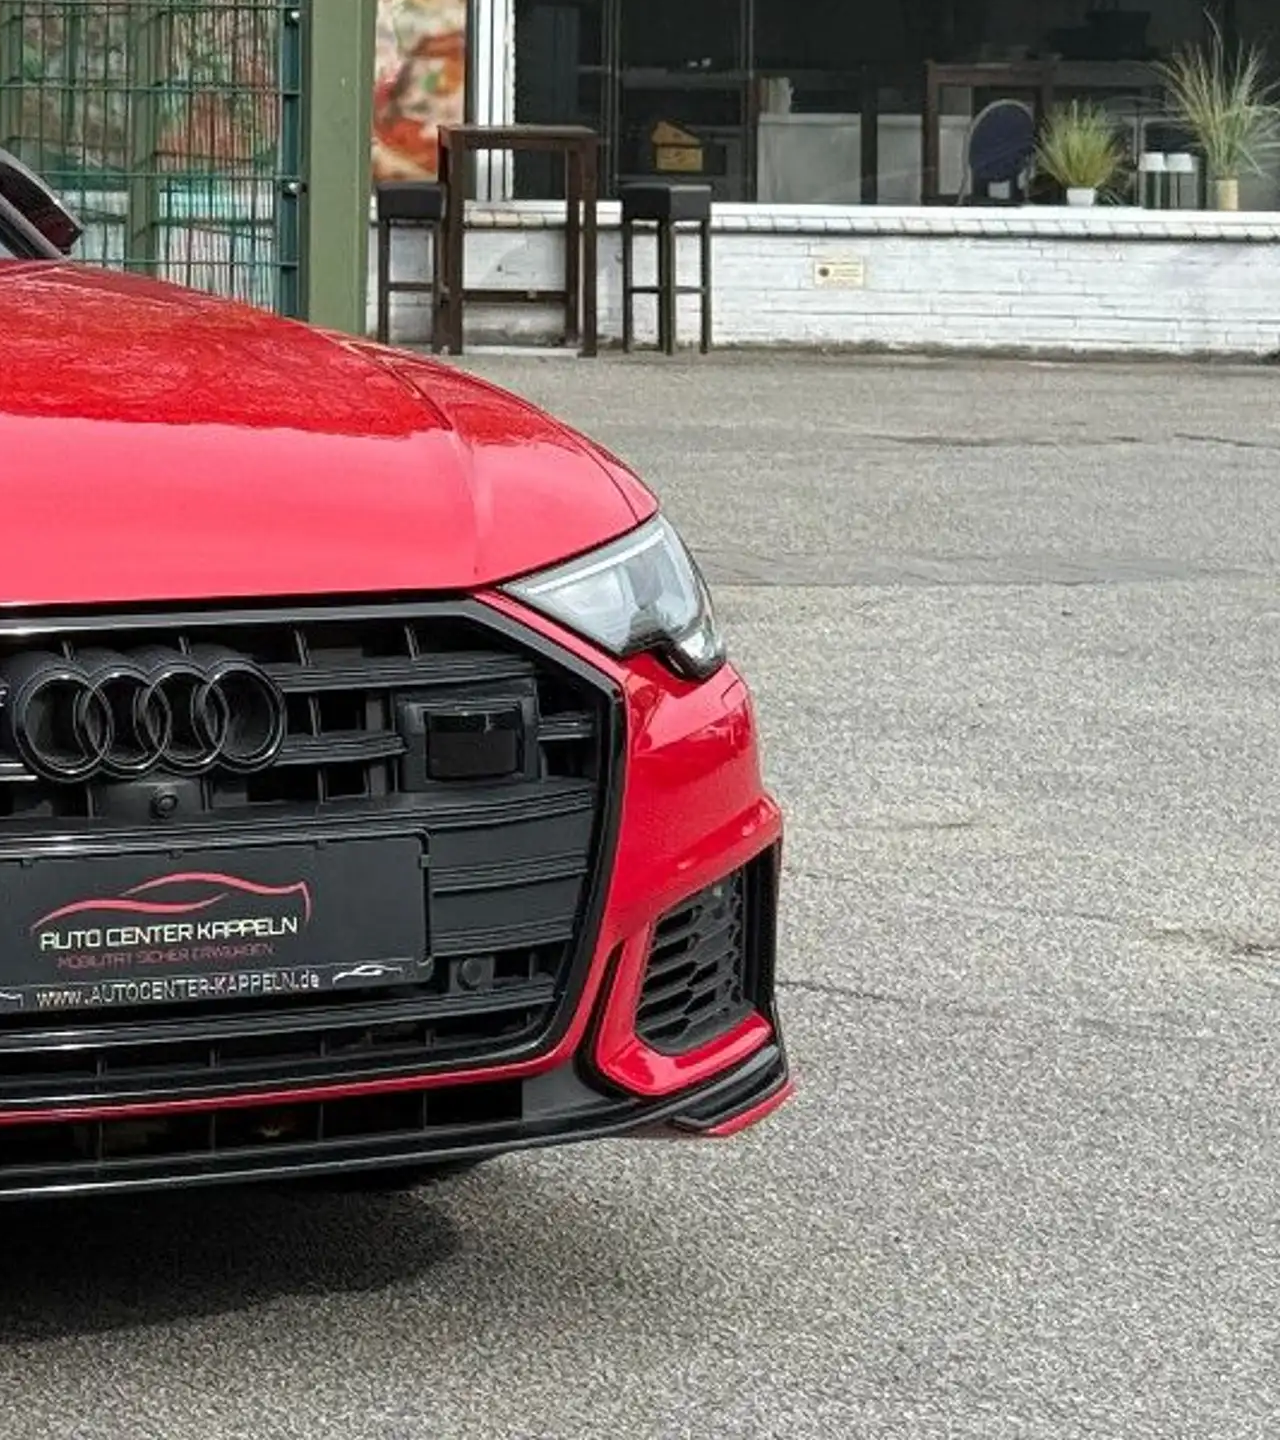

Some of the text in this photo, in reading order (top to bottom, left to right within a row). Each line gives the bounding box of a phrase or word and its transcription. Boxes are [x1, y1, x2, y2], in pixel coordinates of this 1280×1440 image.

[40, 916, 298, 951] AUTO CENTER KAPPELN
